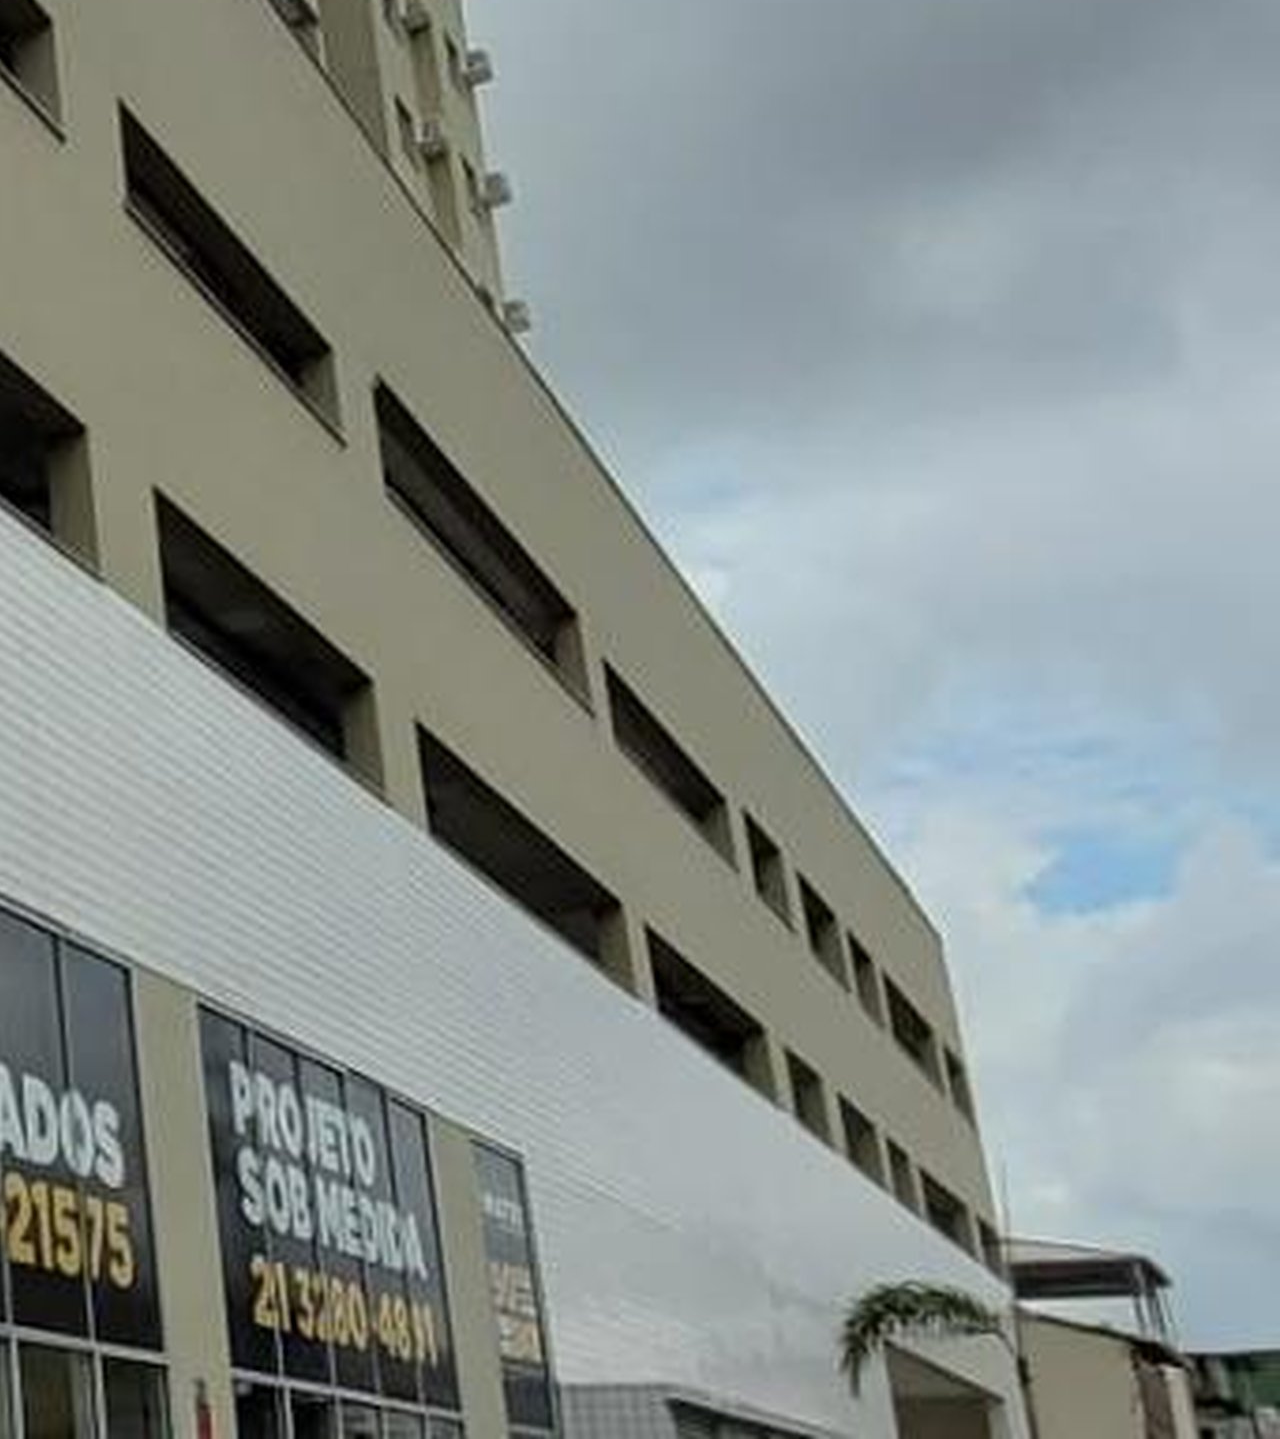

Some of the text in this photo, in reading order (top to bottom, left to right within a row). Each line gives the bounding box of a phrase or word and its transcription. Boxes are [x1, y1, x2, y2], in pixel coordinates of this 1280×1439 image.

[229, 1060, 375, 1188] PROJETO
[238, 1147, 429, 1280] SOB MEDIDA
[250, 1255, 291, 1333] 21
